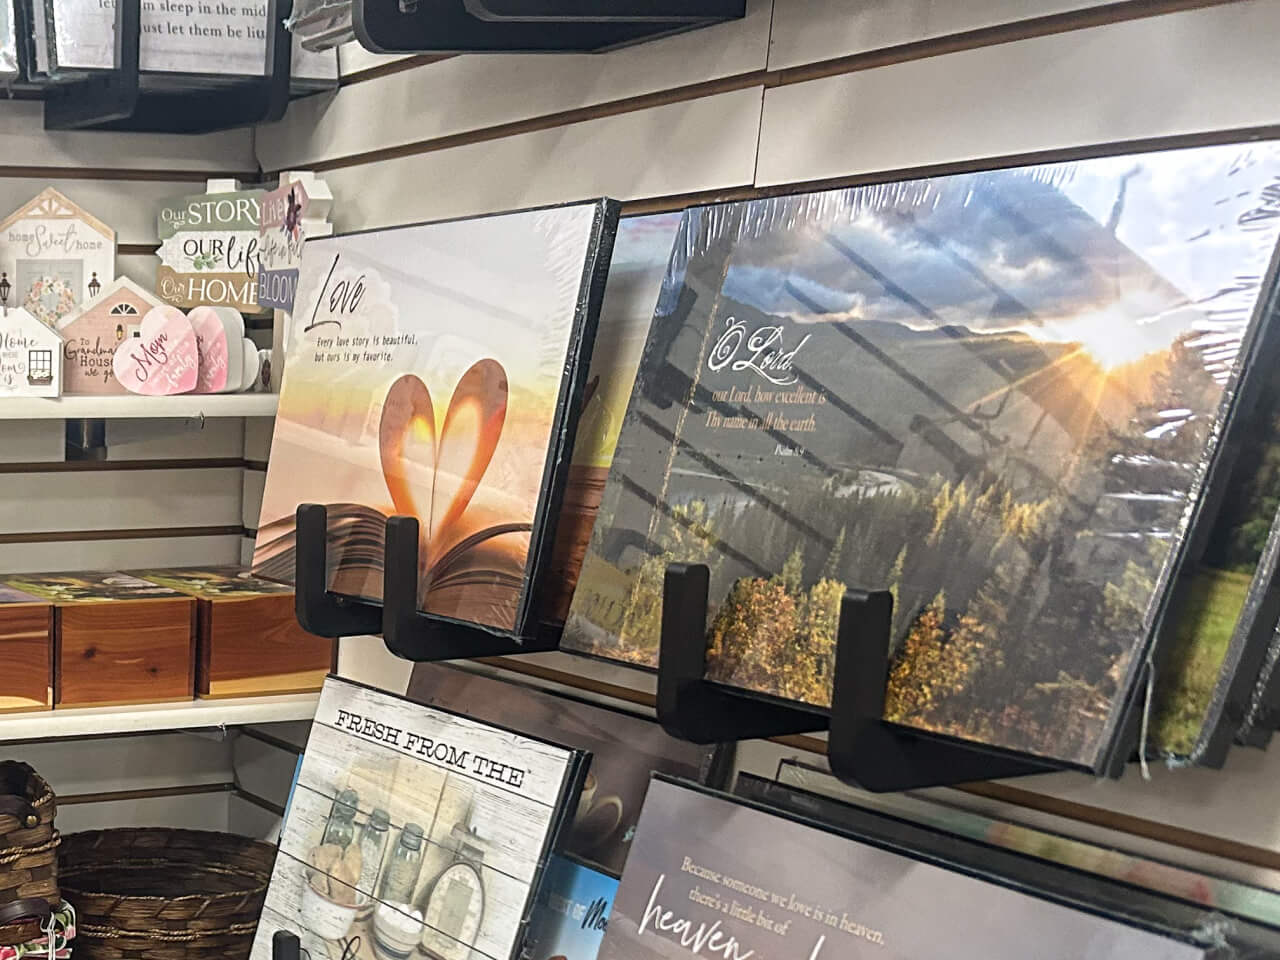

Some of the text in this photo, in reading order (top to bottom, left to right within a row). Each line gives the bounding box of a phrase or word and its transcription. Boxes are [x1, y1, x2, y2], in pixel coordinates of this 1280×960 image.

[159, 0, 194, 17] sleep
[198, 3, 211, 15] in
[216, 5, 236, 17] the
[143, 22, 242, 39] ust let them be
[161, 197, 260, 226] Our STORY
[9, 231, 34, 244] home
[76, 239, 103, 250] home
[183, 239, 224, 258] OUR
[187, 277, 258, 305] HOME
[304, 253, 366, 333] Love
[317, 335, 380, 349] Every love story is
[131, 333, 169, 383] Mom
[314, 351, 324, 362] but
[343, 351, 350, 361] is
[775, 385, 817, 404] excellent
[334, 708, 525, 789] FRESH FROM THE
[680, 855, 839, 928] Because someone we love is in
[729, 898, 756, 925] little
[755, 908, 774, 930] bit
[773, 918, 793, 938] of
